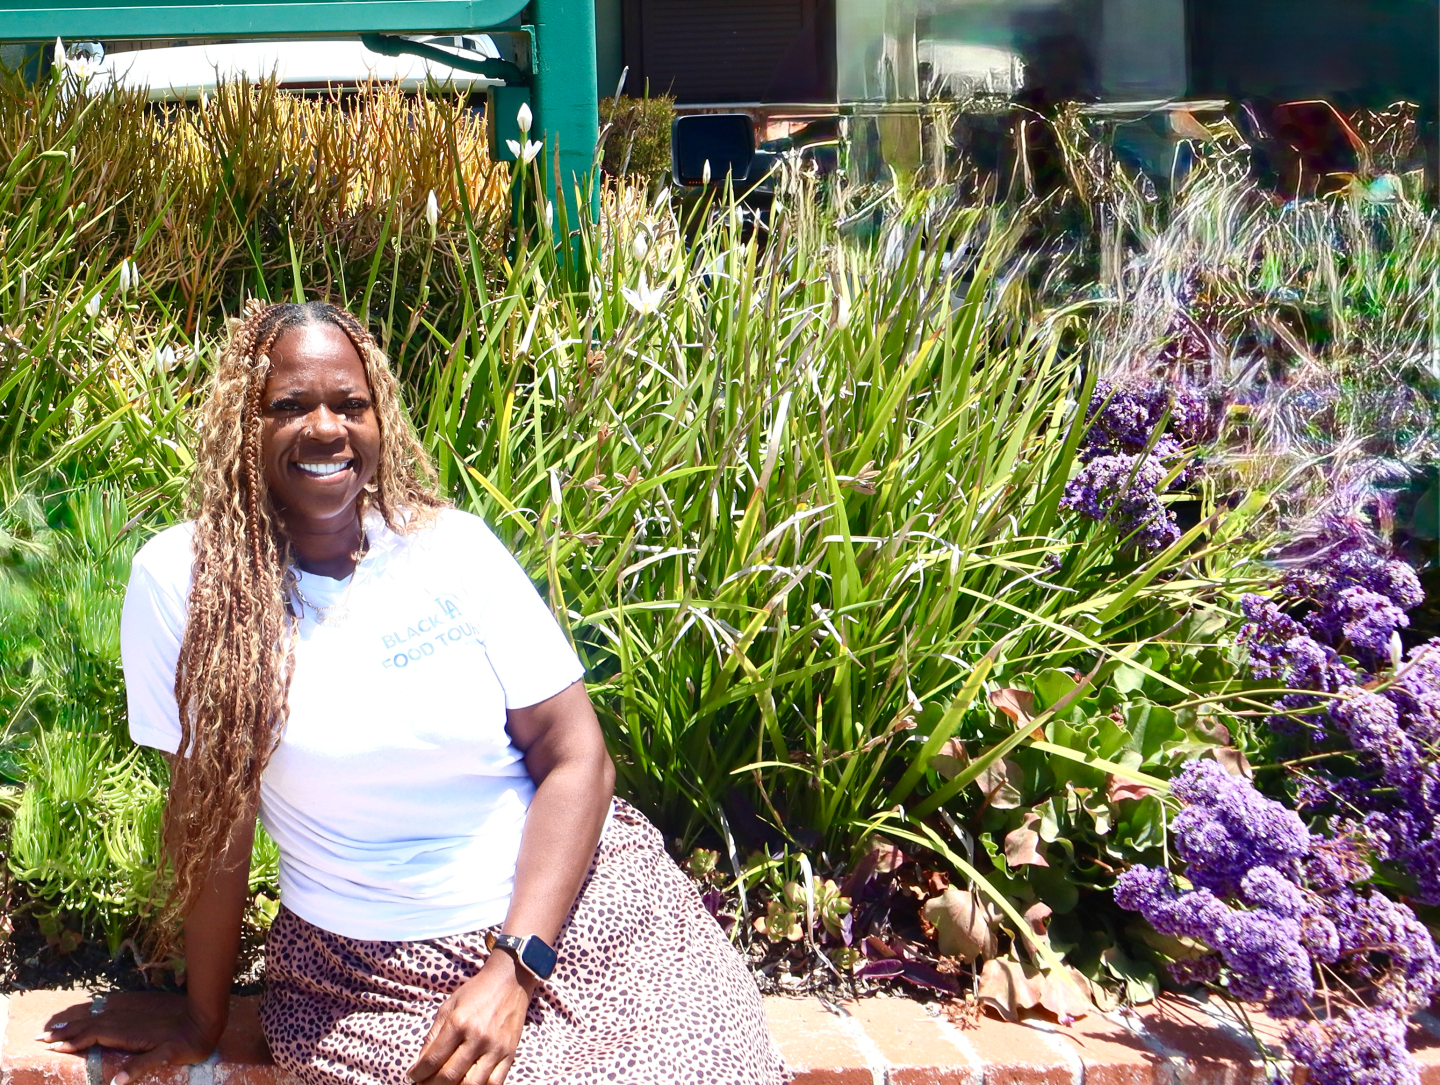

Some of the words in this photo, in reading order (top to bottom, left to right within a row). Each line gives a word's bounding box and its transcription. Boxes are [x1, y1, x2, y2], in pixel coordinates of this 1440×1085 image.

[381, 614, 443, 650] BLACK
[434, 597, 463, 620] LA
[381, 642, 435, 669] FOOD
